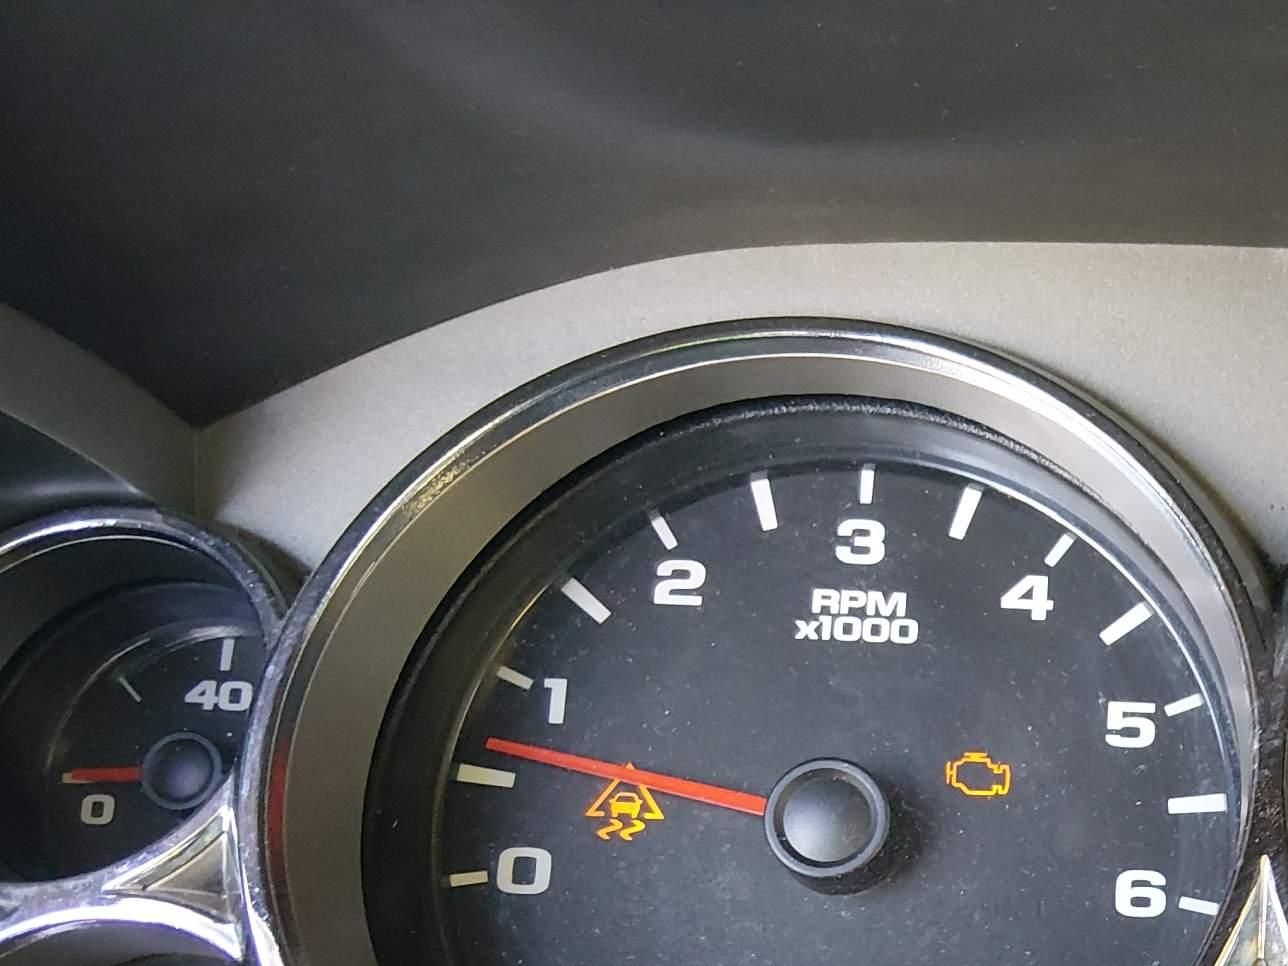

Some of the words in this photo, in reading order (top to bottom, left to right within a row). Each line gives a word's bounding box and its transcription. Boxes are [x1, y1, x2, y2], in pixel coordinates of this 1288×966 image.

[835, 519, 886, 565] 3
[653, 559, 706, 607] 2
[811, 589, 907, 617] RPM
[1000, 575, 1054, 621] 4
[794, 616, 919, 645] x1000
[184, 679, 253, 712] 40
[543, 678, 568, 725] 1
[1105, 701, 1156, 748] 5
[80, 793, 116, 826] 0
[497, 847, 552, 895] 0
[1114, 869, 1167, 918] 6
